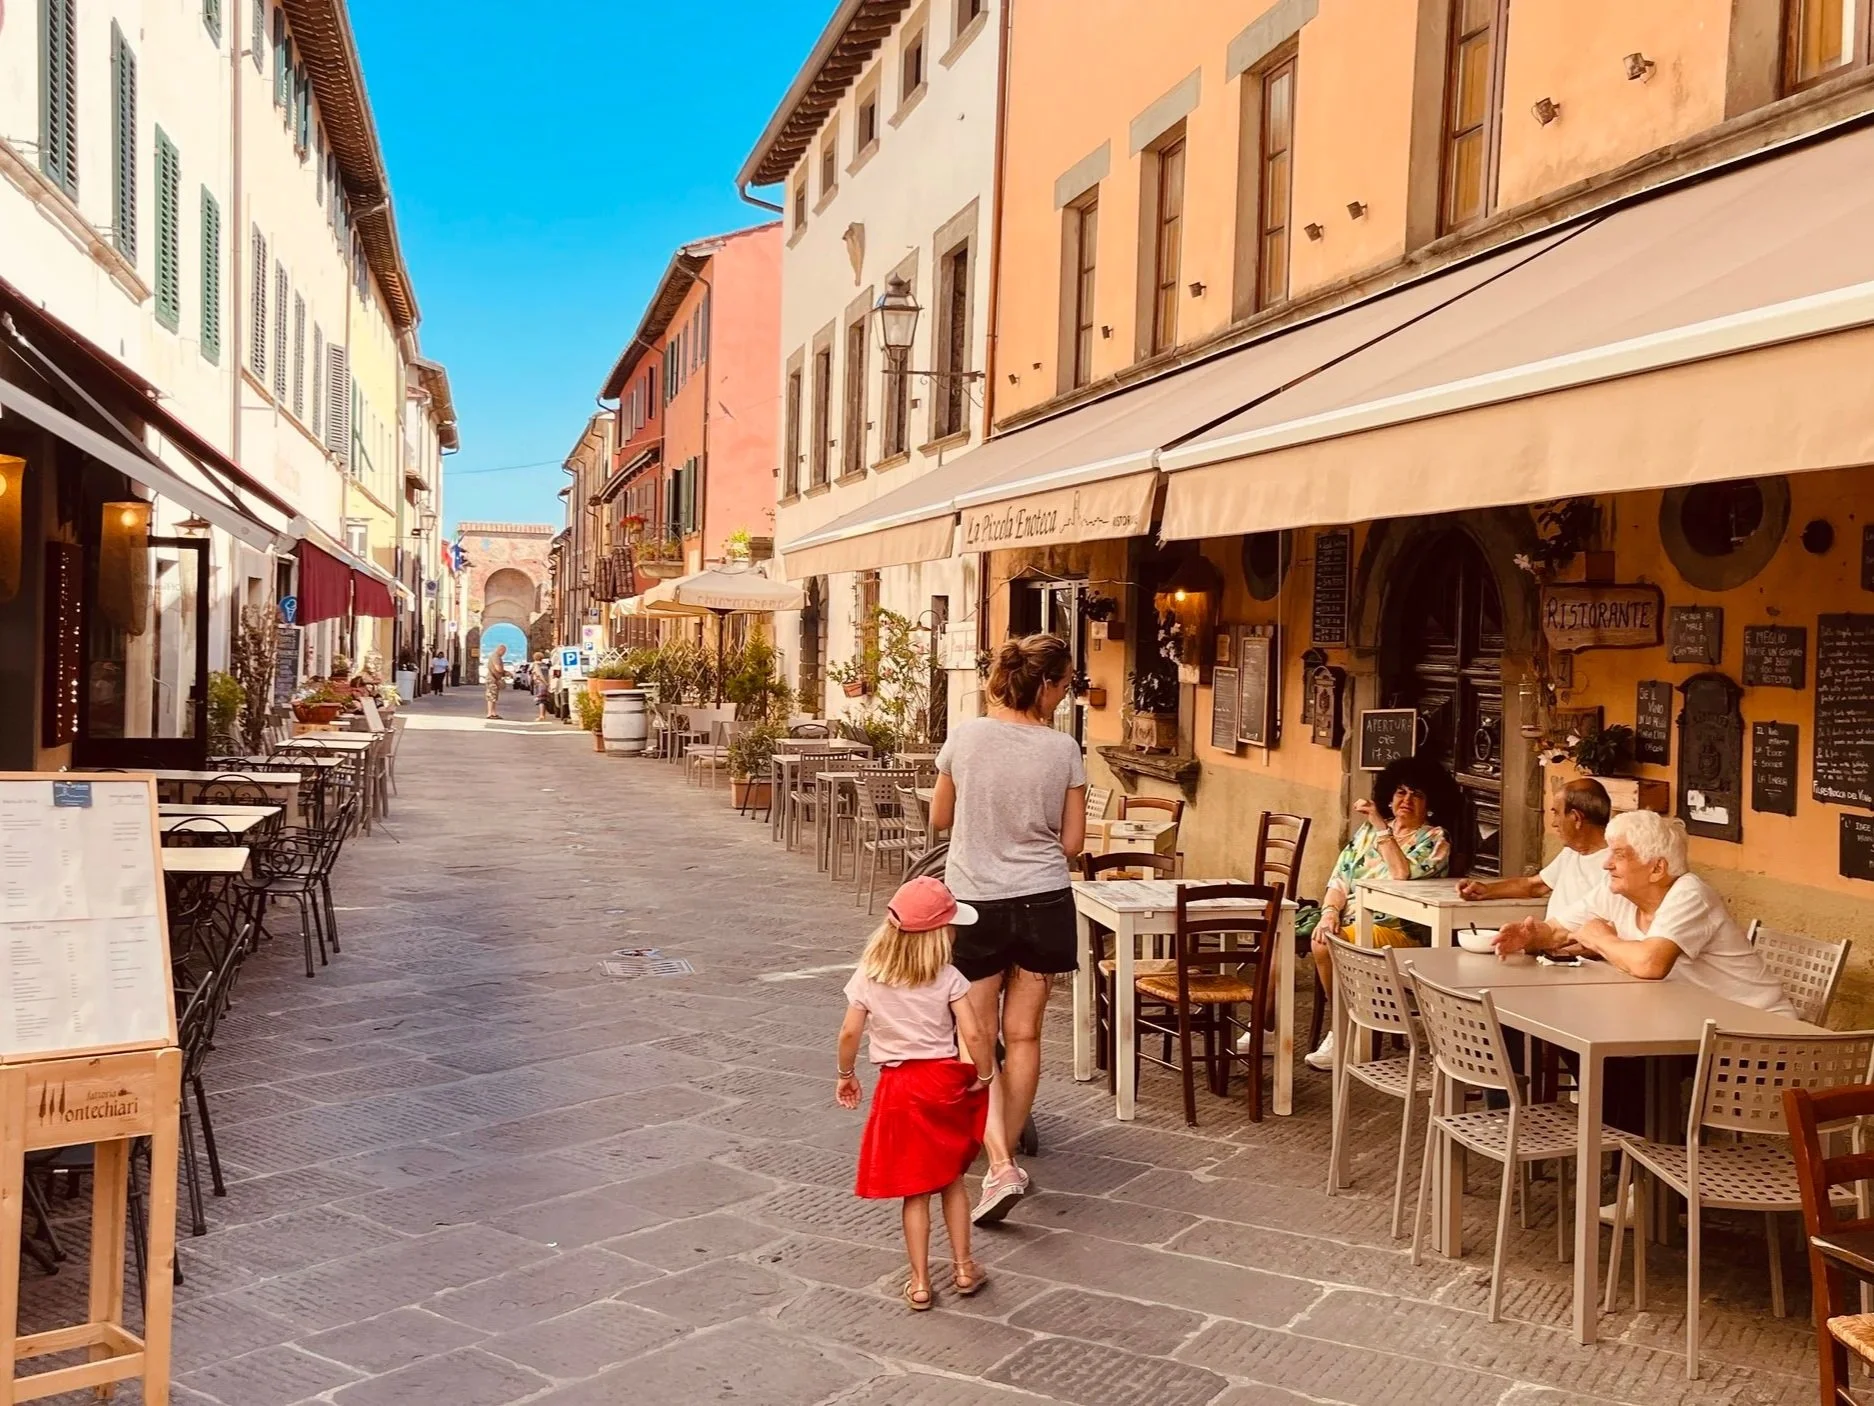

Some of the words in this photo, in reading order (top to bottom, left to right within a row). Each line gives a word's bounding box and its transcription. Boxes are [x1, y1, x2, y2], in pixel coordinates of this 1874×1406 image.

[967, 515, 981, 544] La
[981, 505, 1014, 542] Piccola
[1014, 508, 1057, 539] Enoteca
[1547, 597, 1652, 629] RISTORANTE
[1366, 718, 1413, 734] APERTURA
[1377, 734, 1396, 745] ORE
